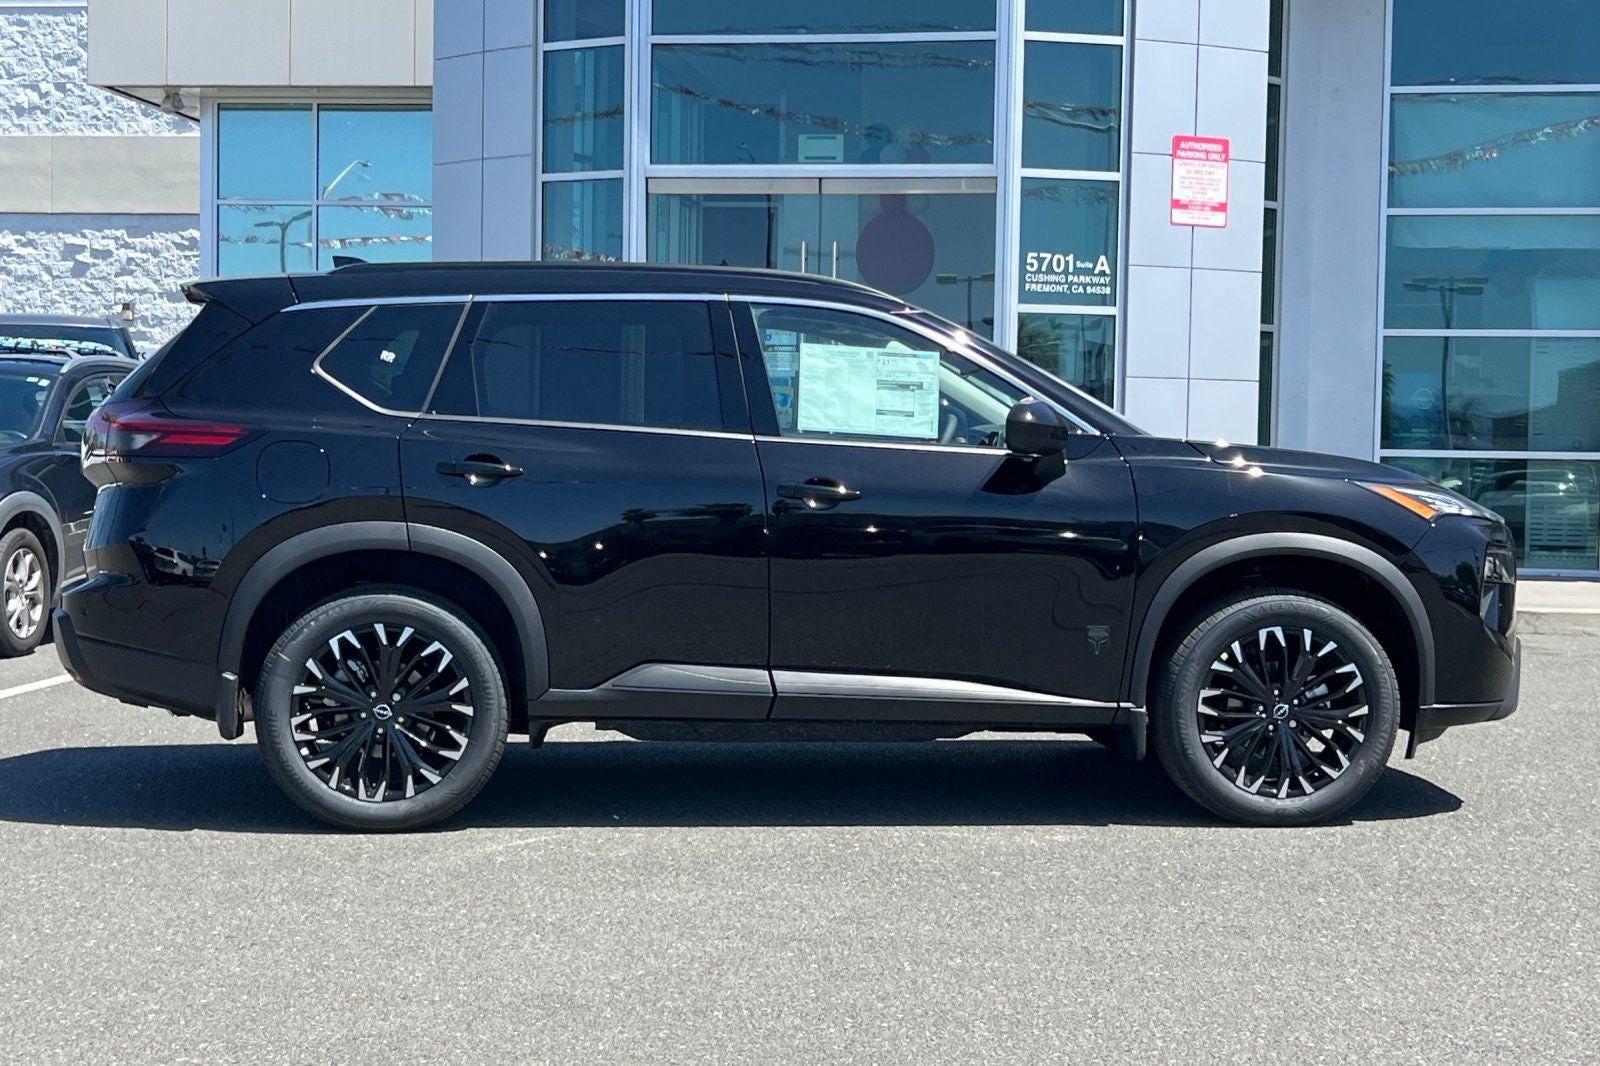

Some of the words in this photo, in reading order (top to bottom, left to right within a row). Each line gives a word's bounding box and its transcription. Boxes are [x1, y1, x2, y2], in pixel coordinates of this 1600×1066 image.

[1180, 140, 1224, 152] AUTHORIZED
[1176, 150, 1207, 161] PARKING
[1207, 152, 1226, 162] ONLY
[1025, 252, 1074, 273] 5701
[1075, 261, 1093, 269] Suite
[1093, 255, 1111, 274] A
[1024, 273, 1066, 283] CUSHING
[1067, 274, 1111, 284] PARKWAY
[1024, 283, 1070, 294] FREMONT,
[1071, 285, 1084, 294] CA
[1085, 286, 1111, 295] 94538
